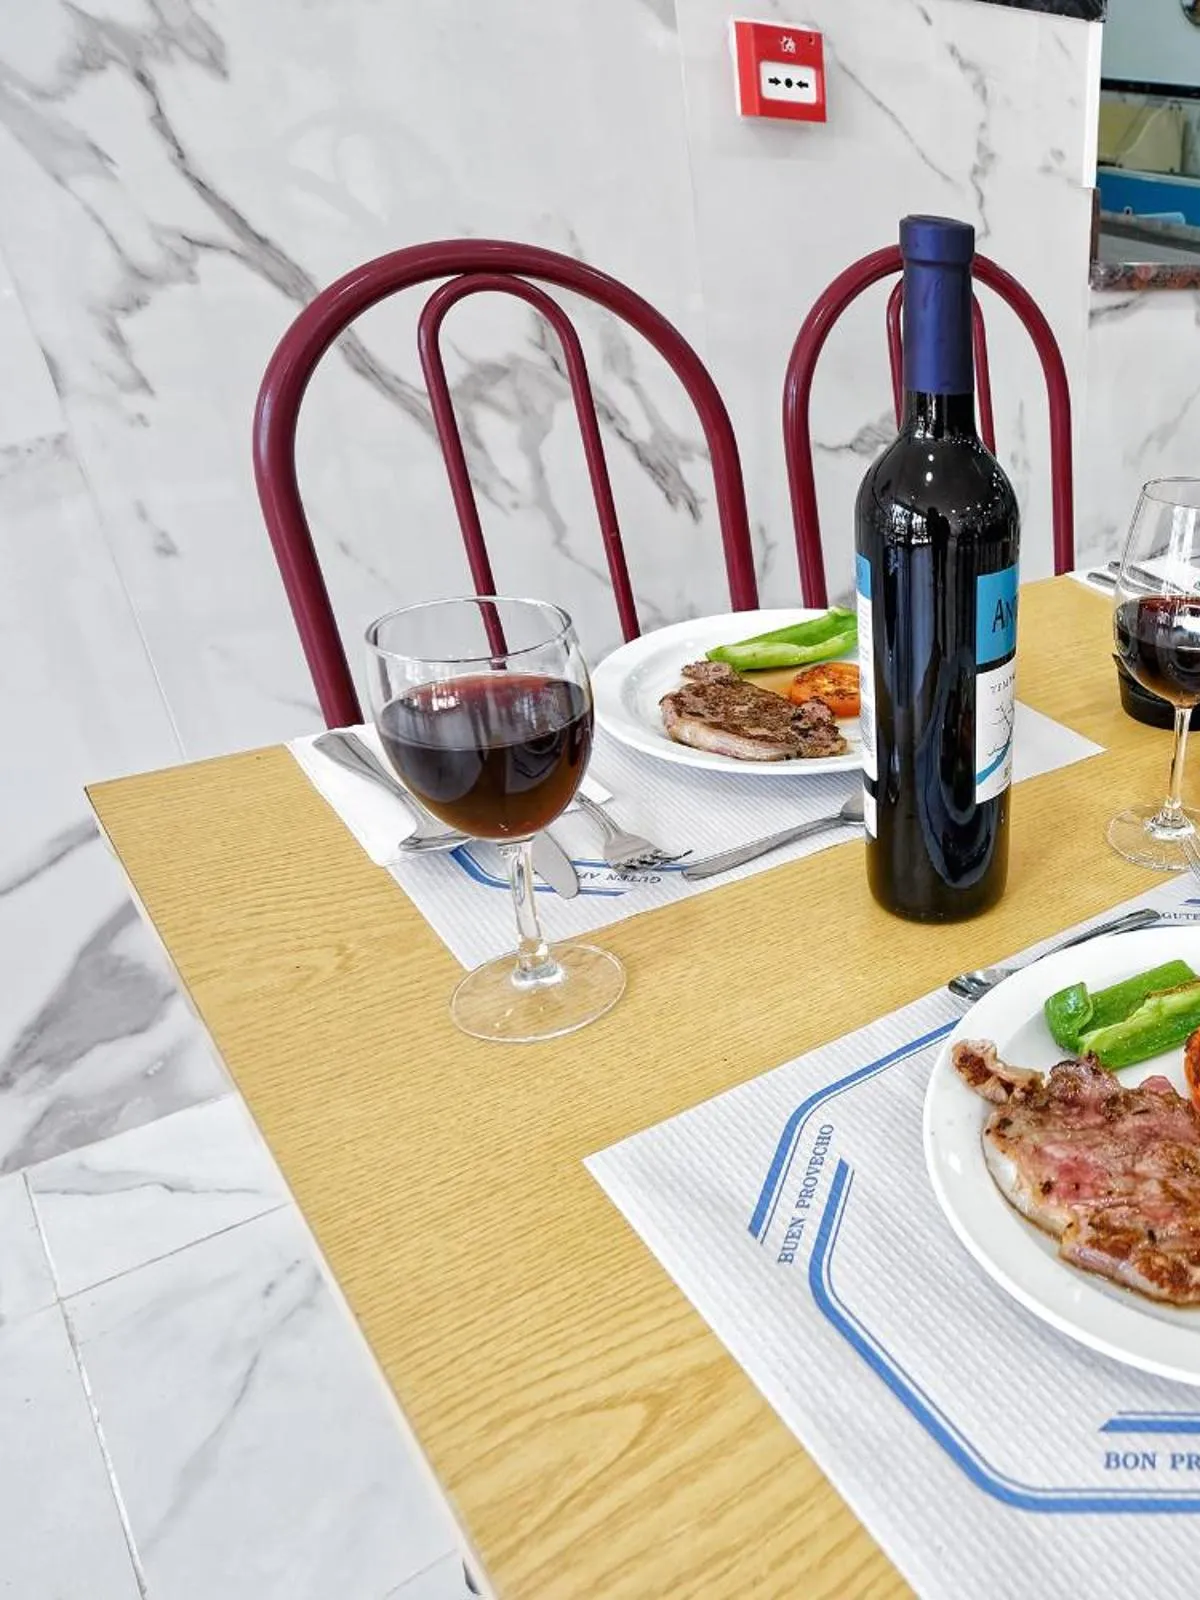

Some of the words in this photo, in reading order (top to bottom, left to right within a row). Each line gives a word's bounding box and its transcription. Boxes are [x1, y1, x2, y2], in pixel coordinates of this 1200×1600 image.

[991, 593, 1018, 633] AN
[777, 1216, 806, 1265] BUEN
[795, 1123, 835, 1210] PROVECHO
[1104, 1451, 1157, 1470] BON
